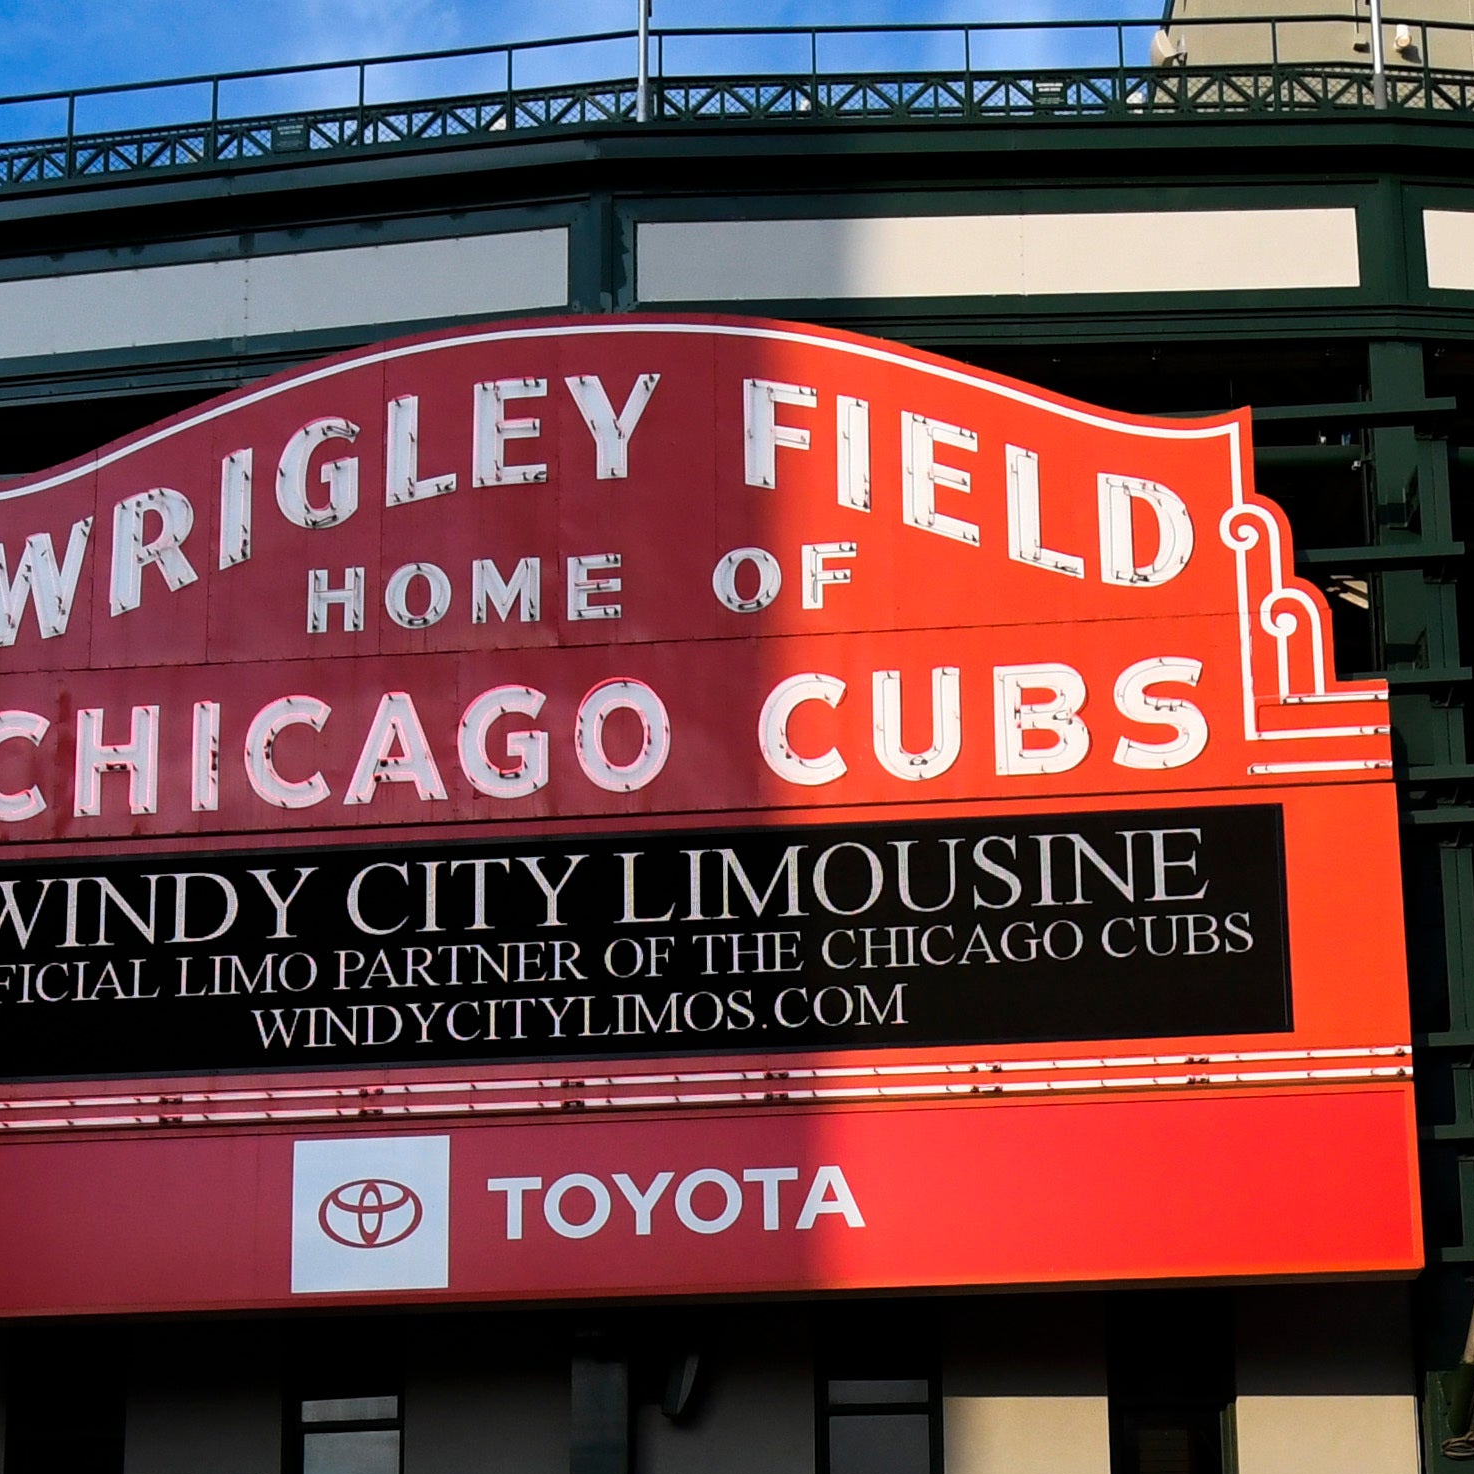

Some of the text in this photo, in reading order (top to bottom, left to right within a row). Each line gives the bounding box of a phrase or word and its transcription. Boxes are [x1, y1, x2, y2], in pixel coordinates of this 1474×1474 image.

[743, 378, 1194, 588] FIELD
[306, 541, 858, 634] HOME OF
[757, 656, 1208, 787] CUBS
[346, 854, 590, 936] CITY
[613, 827, 1210, 924] LIMOUSINE
[174, 952, 319, 997] LIMO
[332, 940, 589, 991] PARTNER
[603, 936, 675, 980] OF
[692, 930, 805, 976] THE
[821, 919, 1084, 970] CHICAGO
[1101, 911, 1254, 958] CUBS
[250, 983, 909, 1049] WINDYCITYLIMOS.COM
[487, 1165, 867, 1240] TOYOTA
